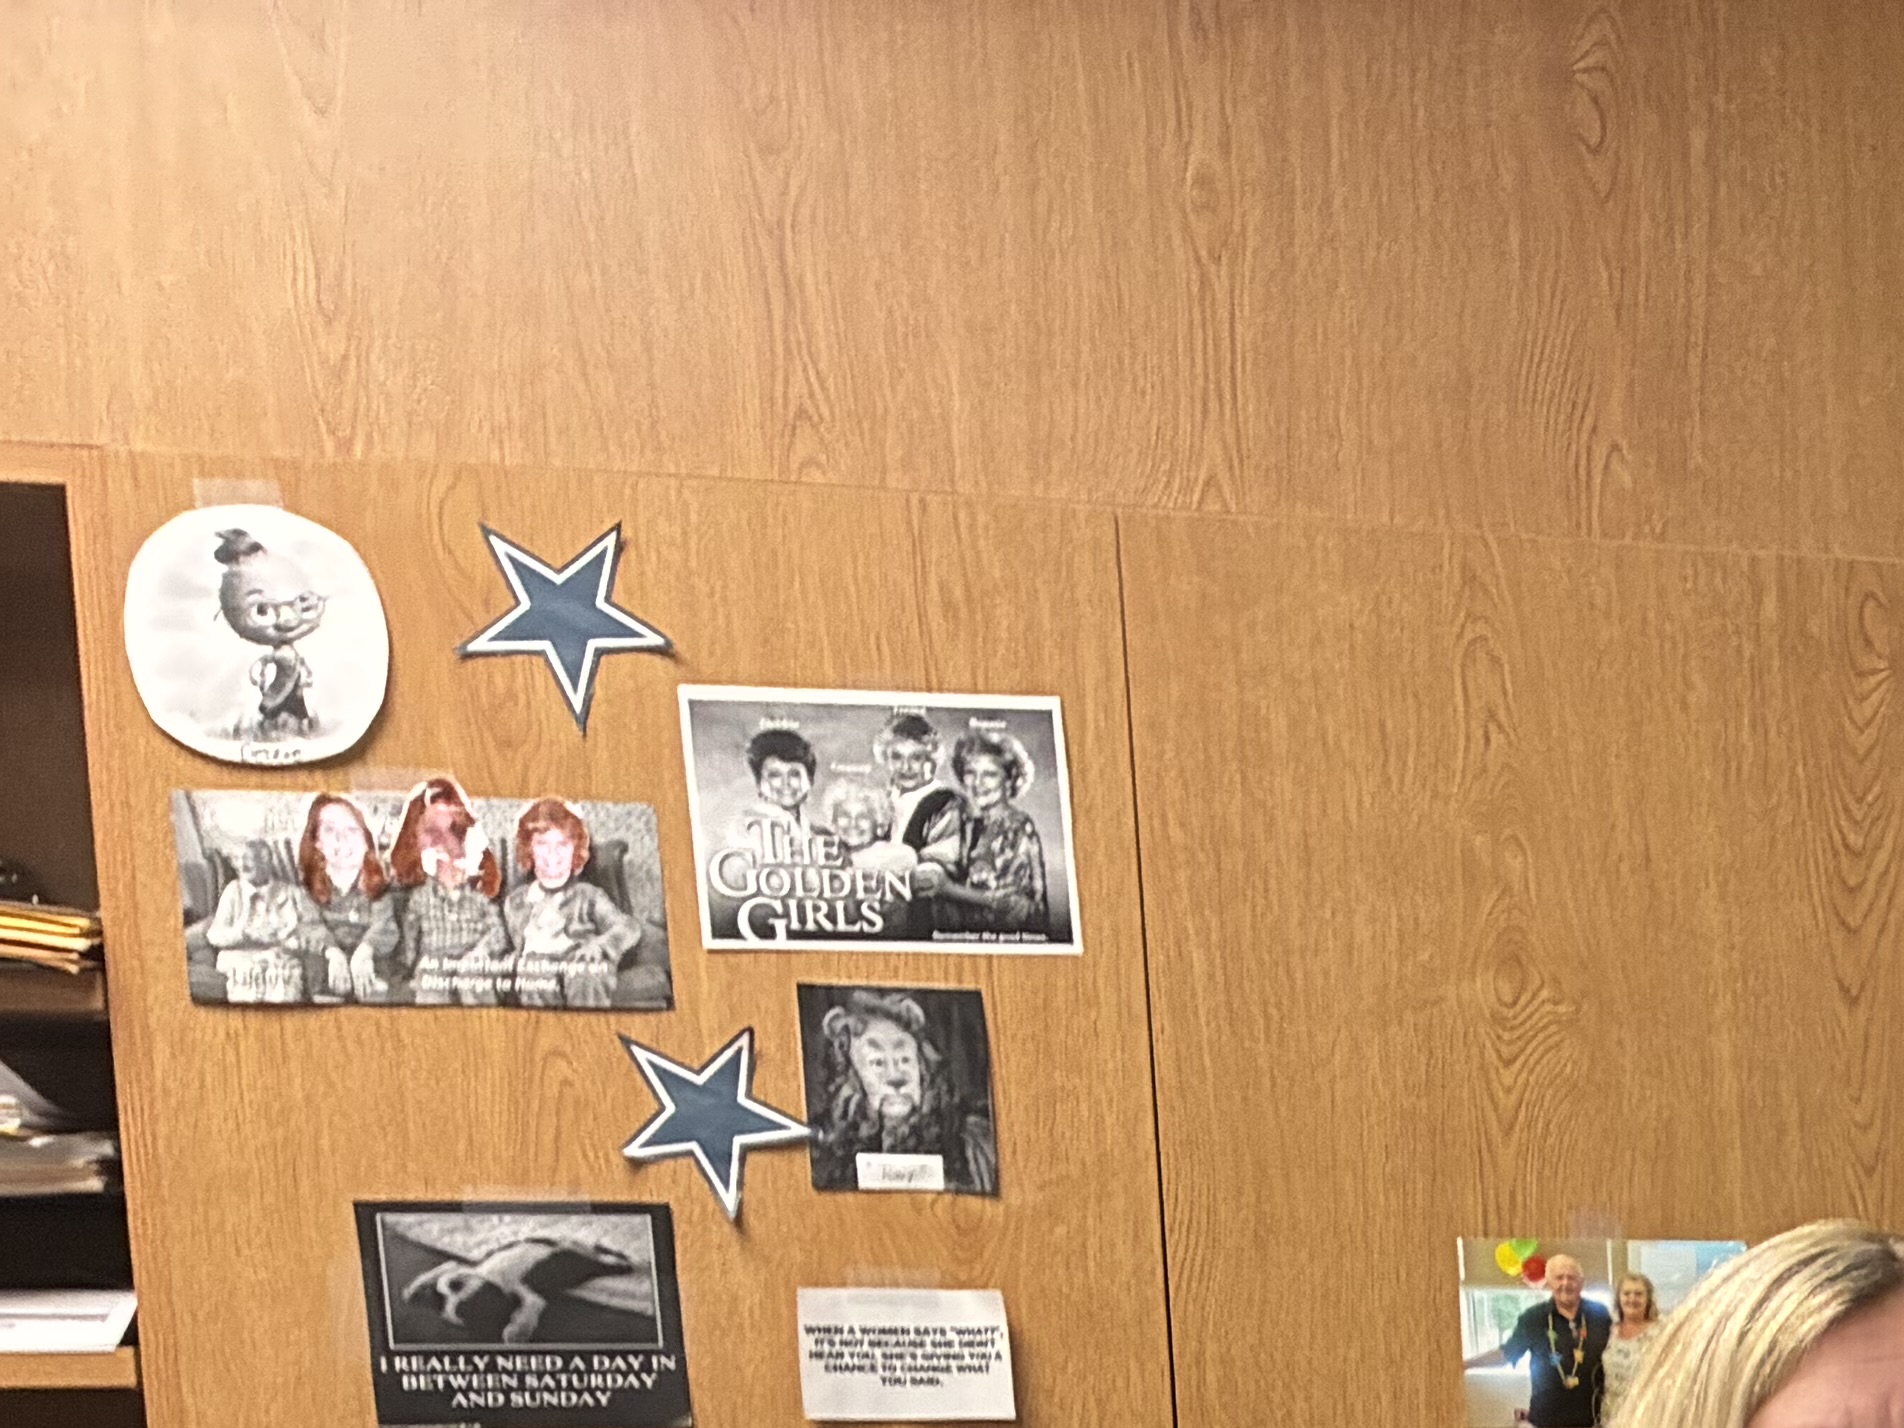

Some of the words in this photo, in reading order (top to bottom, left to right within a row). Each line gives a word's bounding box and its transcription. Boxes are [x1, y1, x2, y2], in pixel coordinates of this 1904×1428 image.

[746, 819, 843, 867] THE
[709, 849, 913, 901] GOLDEN
[737, 897, 884, 942] GIRLS
[380, 1355, 388, 1374] I
[394, 1354, 490, 1372] REALLY
[496, 1354, 564, 1372] NEED
[569, 1355, 586, 1371] A
[592, 1354, 644, 1372] DAY
[651, 1353, 677, 1371] IN
[402, 1373, 519, 1391] BETWEEN
[524, 1372, 657, 1390] SATURDAY
[451, 1391, 505, 1408] AND
[510, 1391, 611, 1408] SUNDAY
